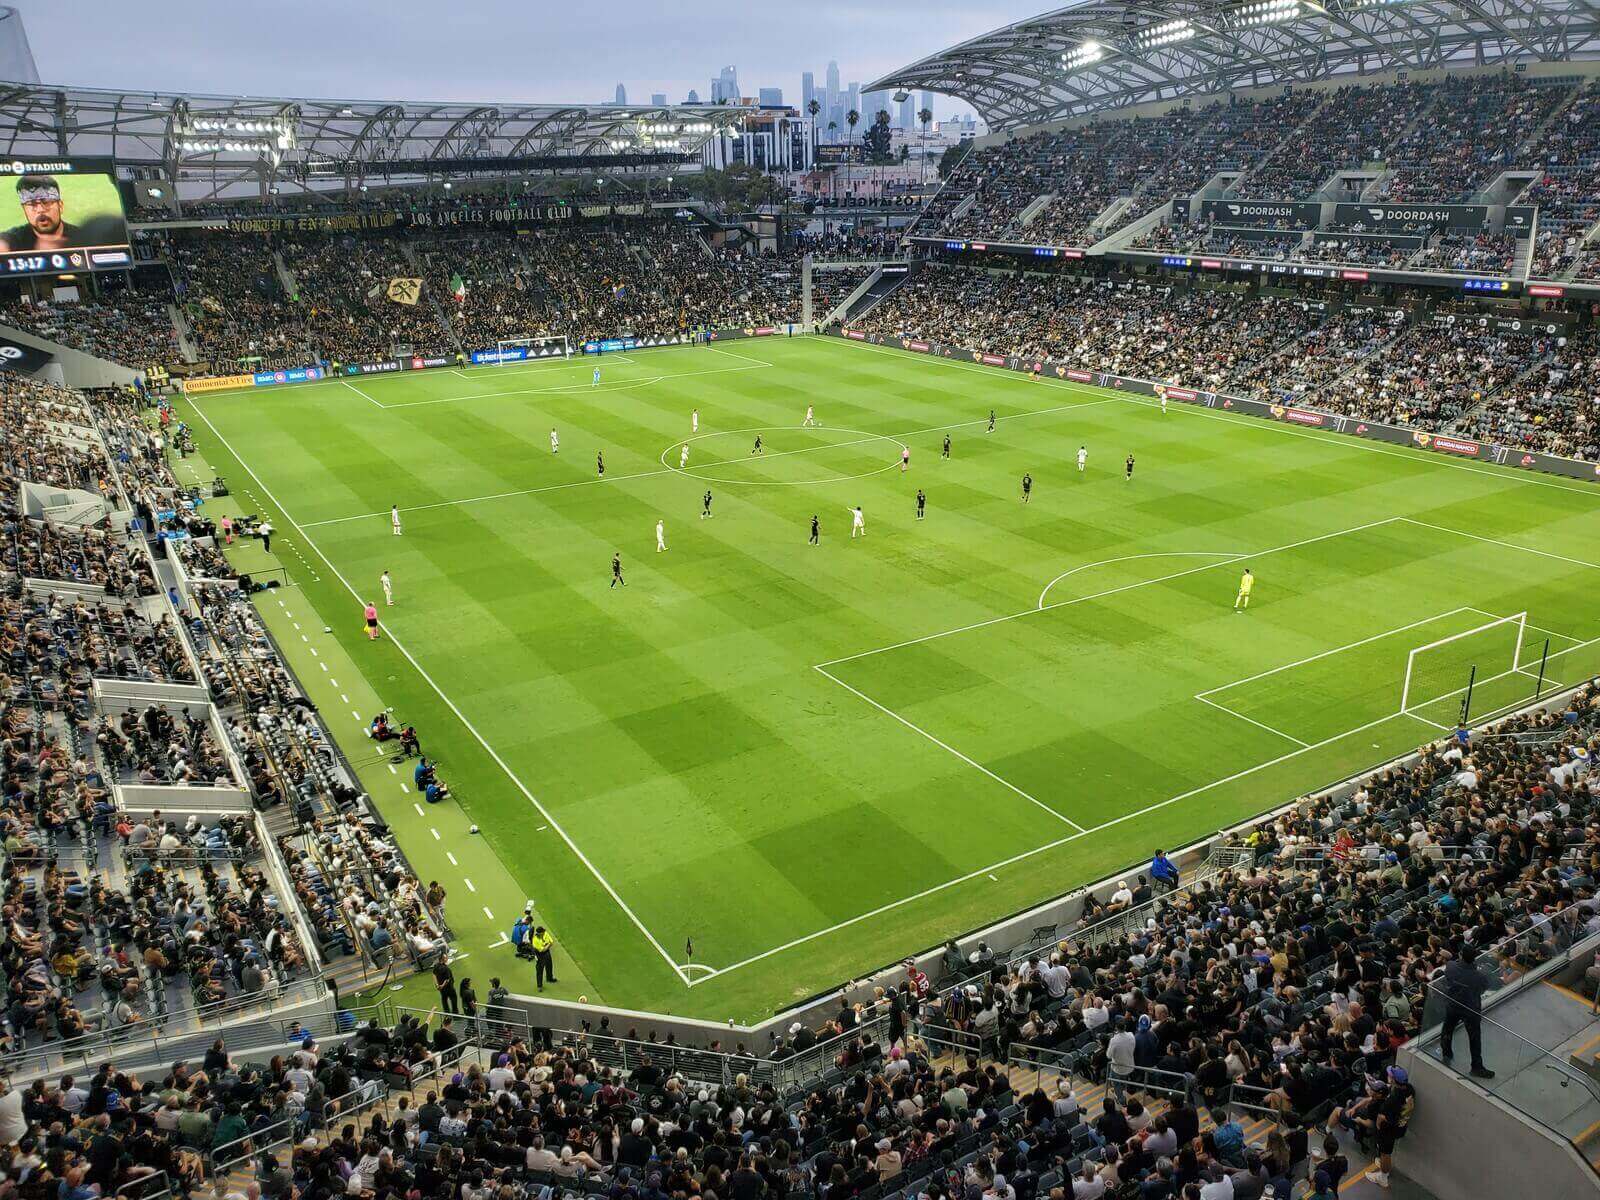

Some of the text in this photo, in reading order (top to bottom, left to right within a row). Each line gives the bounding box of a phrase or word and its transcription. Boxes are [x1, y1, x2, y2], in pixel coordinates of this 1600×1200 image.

[26, 162, 72, 172] STADIUM
[411, 212, 432, 225] LOS
[438, 210, 483, 224] ANGELES
[489, 208, 542, 221] FOOTBALL
[547, 206, 572, 219] CLUB
[1243, 206, 1292, 216] DOORDASH
[1387, 210, 1449, 221] DOORDASH
[231, 219, 280, 232] NORTH
[8, 257, 43, 271] 13:17
[52, 254, 64, 268] 0
[363, 362, 397, 372] WAYMO
[186, 378, 230, 391] Continental
